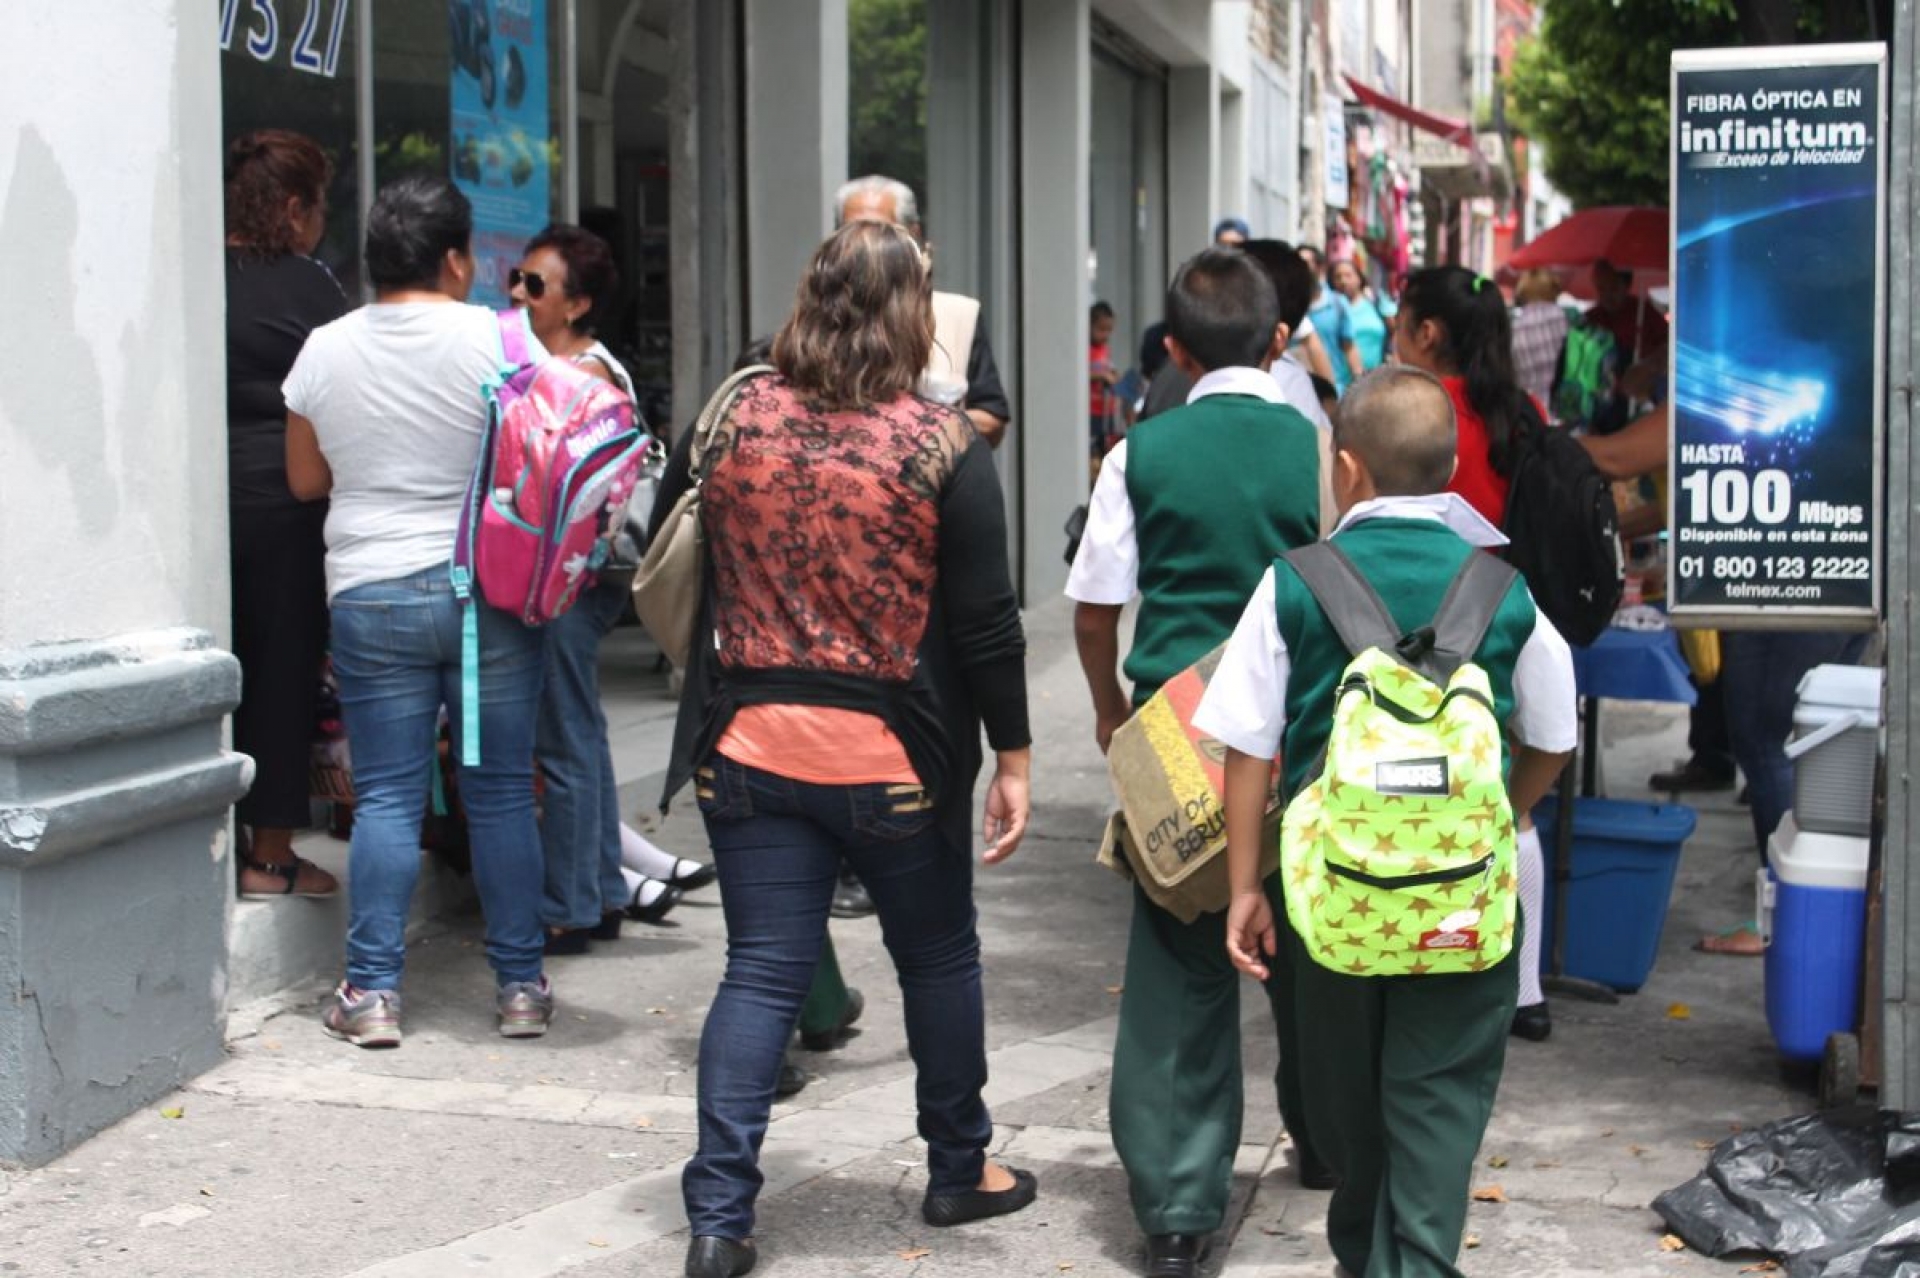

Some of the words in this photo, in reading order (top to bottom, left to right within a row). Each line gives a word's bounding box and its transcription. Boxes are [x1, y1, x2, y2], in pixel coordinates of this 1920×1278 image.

[1687, 93, 1747, 114] FIBRA
[1751, 88, 1828, 111] ÓPTICA
[1833, 88, 1862, 108] EN
[1680, 117, 1867, 152] infinitum
[1715, 152, 1768, 167] Exceso
[1769, 151, 1790, 166] de
[1792, 148, 1866, 165] Velocidad
[1681, 445, 1745, 465] HASTA
[1681, 469, 1792, 524] 100
[1798, 501, 1864, 528] Mbps
[1680, 528, 1763, 544] Disponible
[1767, 531, 1787, 542] en
[1791, 529, 1826, 543] esta
[1830, 531, 1868, 543] zona
[1679, 556, 1704, 578] 01
[1713, 556, 1756, 578] 800
[1762, 556, 1805, 579] 123
[1811, 557, 1870, 579] 2222
[1724, 582, 1821, 598] telmex.com
[1147, 809, 1180, 853] CITY
[1185, 791, 1211, 821] OF
[1172, 805, 1226, 863] BERLI
